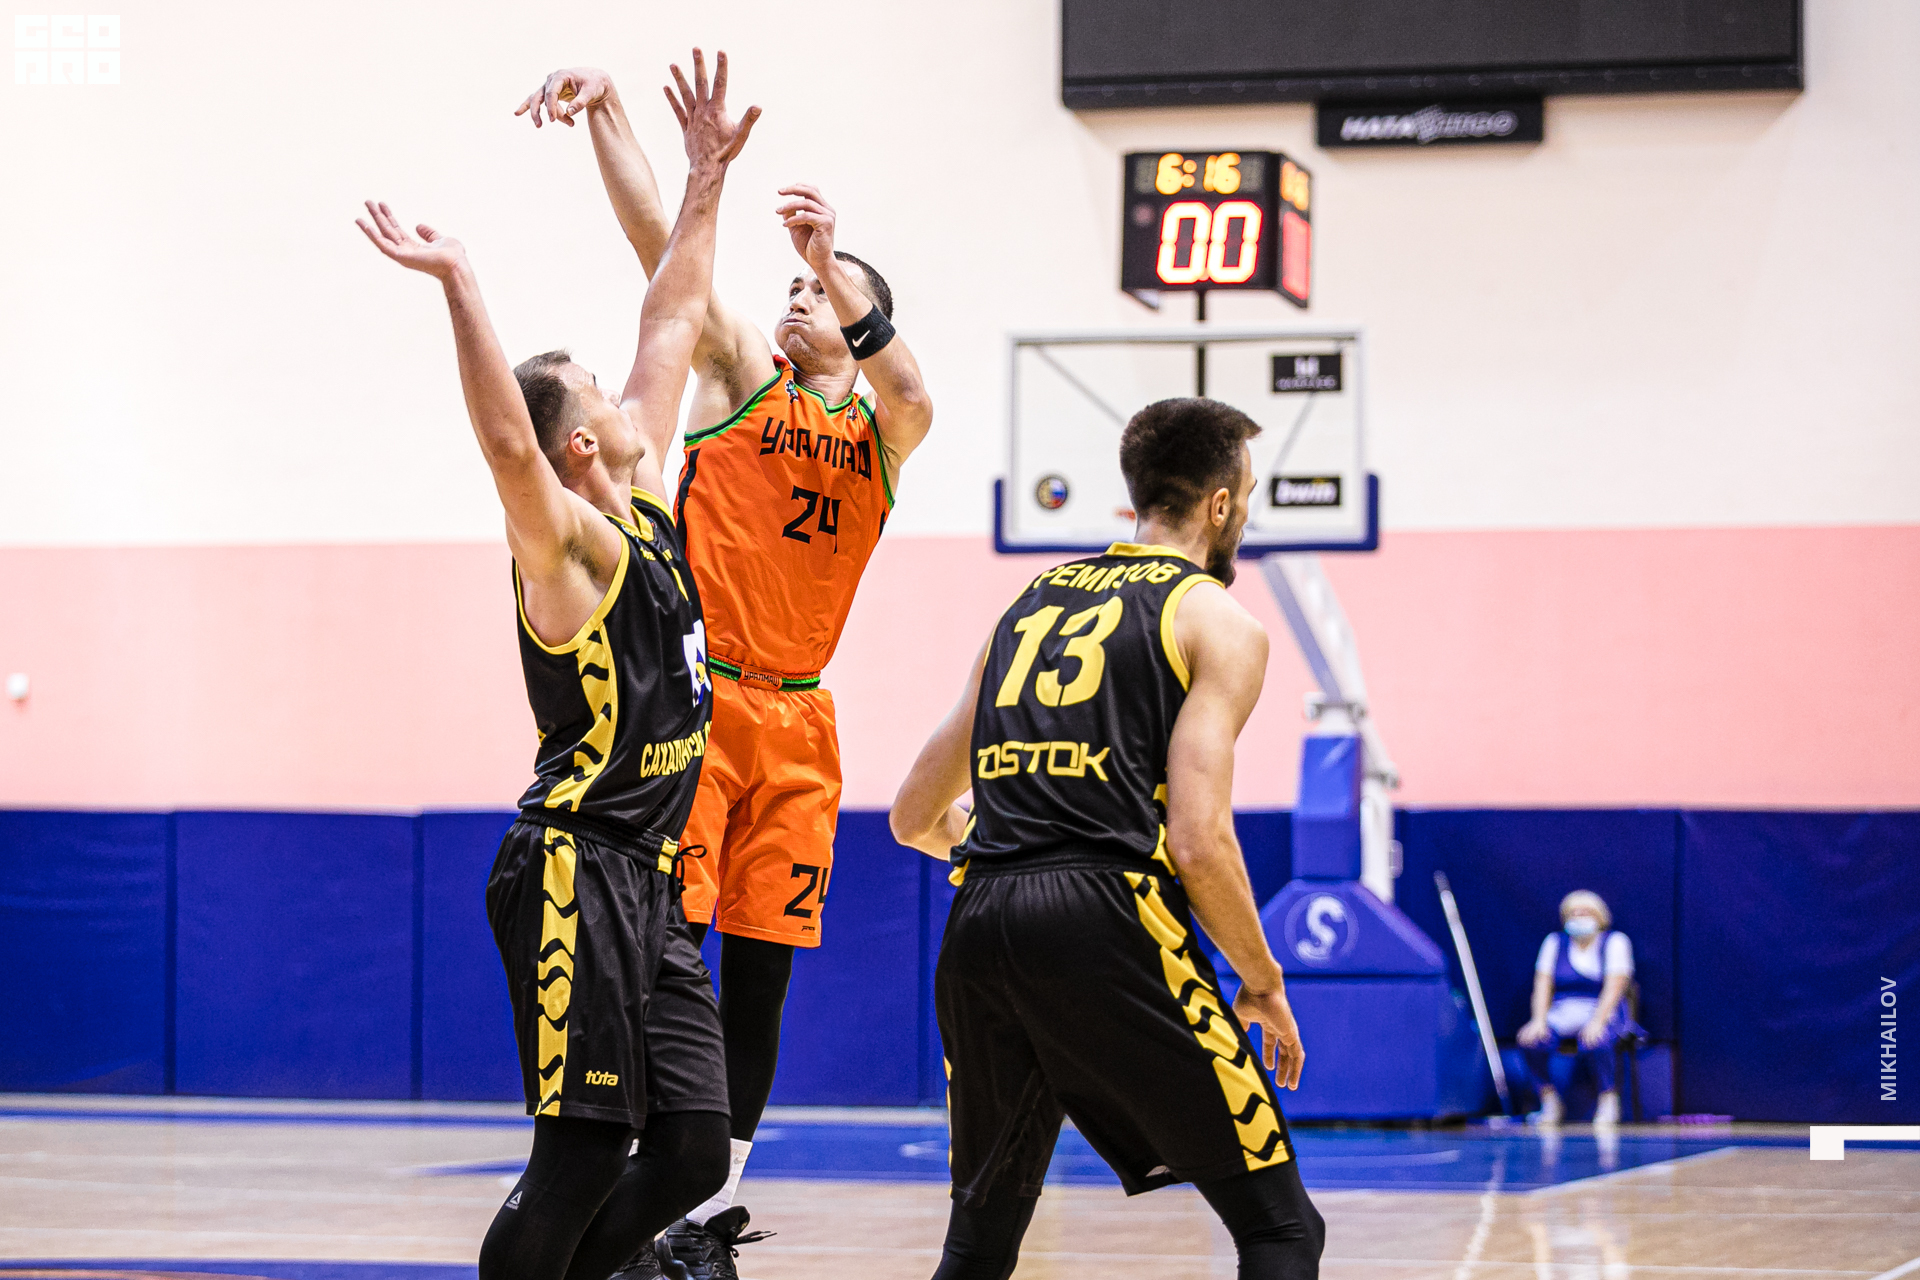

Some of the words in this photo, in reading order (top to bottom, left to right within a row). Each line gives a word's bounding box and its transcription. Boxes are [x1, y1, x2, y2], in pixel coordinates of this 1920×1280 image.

[1155, 153, 1241, 195] 6:16
[1156, 200, 1263, 284] 00
[781, 485, 843, 554] 24
[995, 596, 1123, 708] 13
[977, 740, 1111, 782] OSTOK
